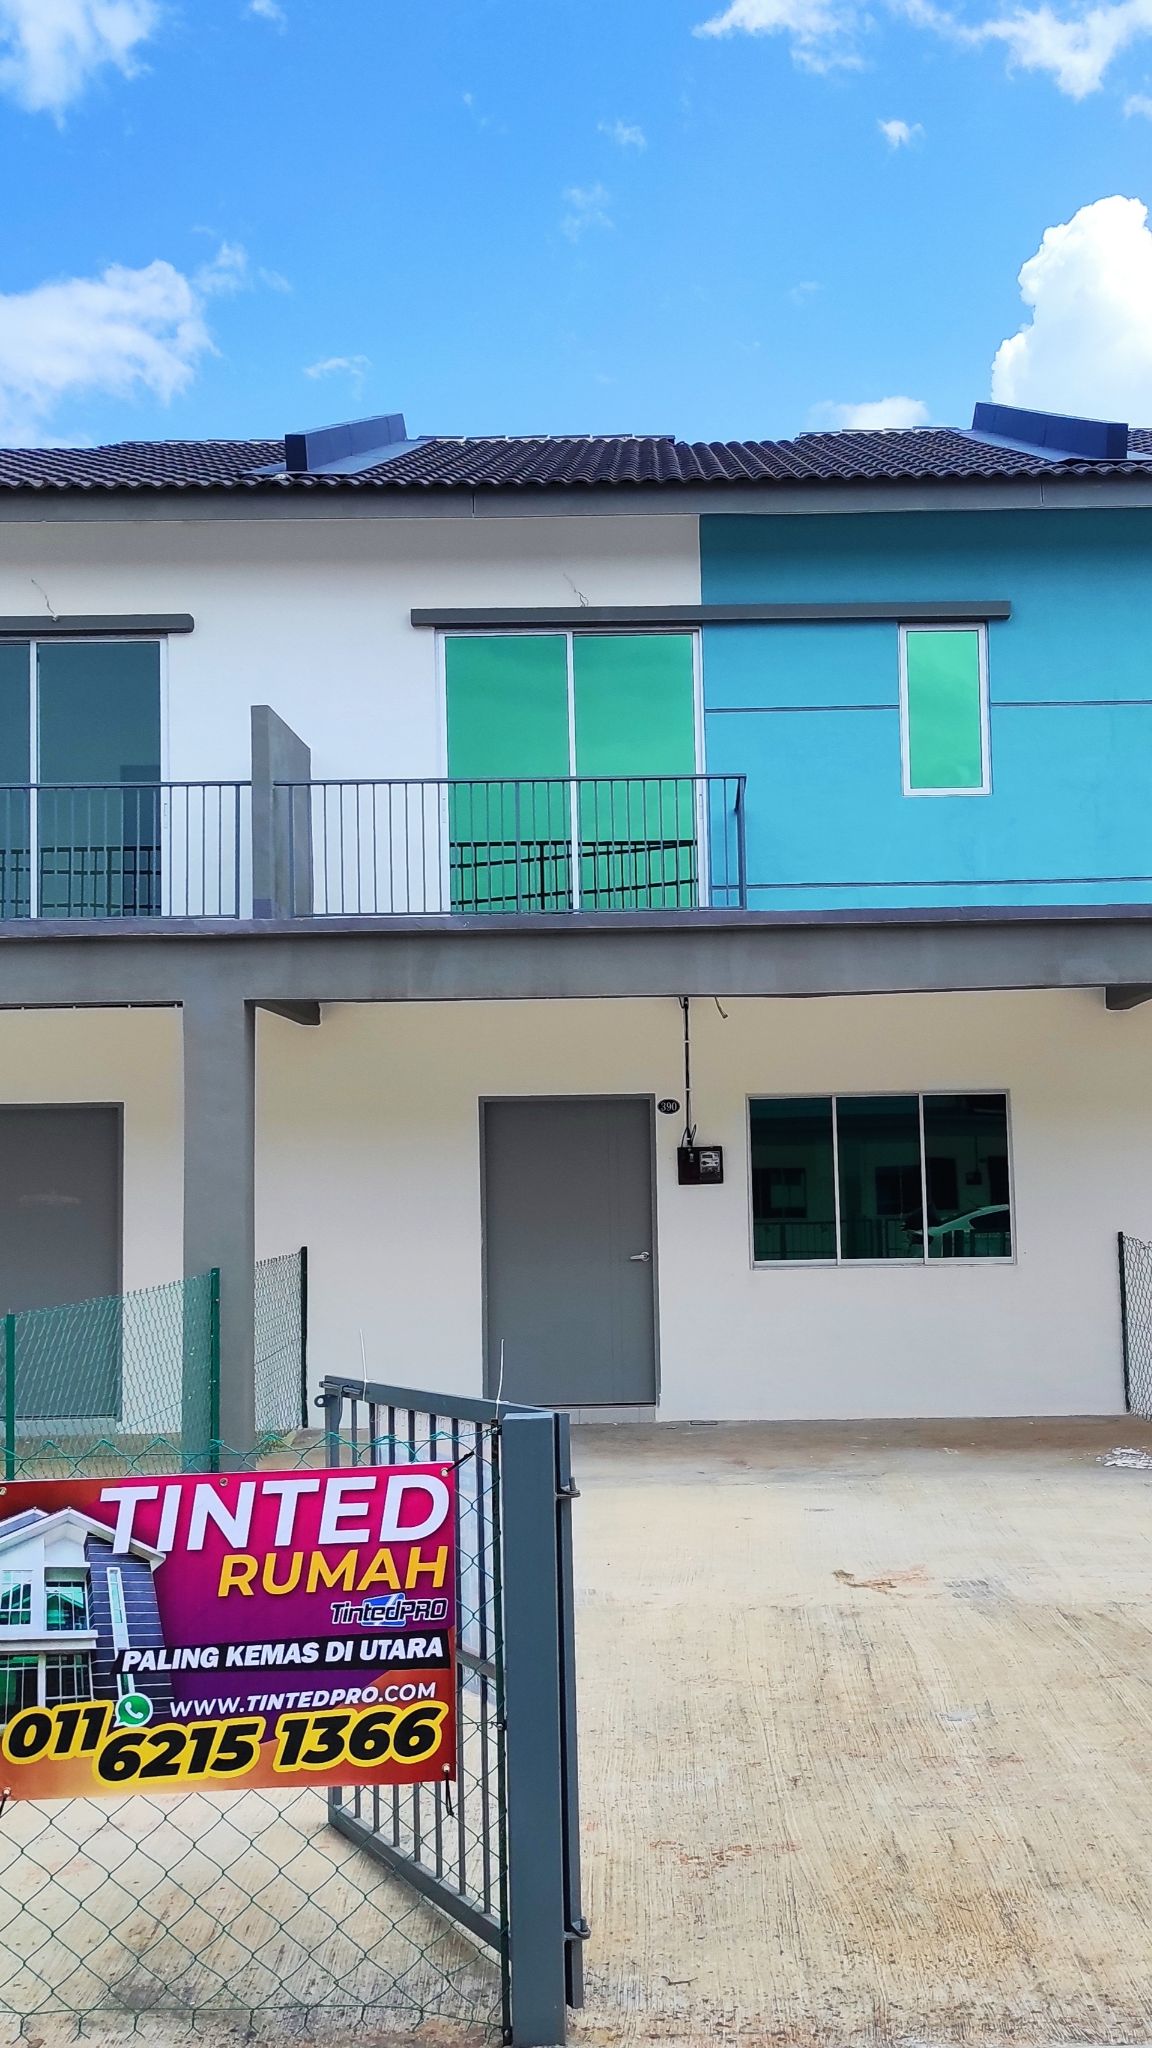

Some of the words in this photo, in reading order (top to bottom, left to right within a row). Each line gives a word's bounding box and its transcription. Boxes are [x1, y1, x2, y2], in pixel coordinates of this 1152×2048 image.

[660, 1101, 678, 1112] 390
[100, 1474, 450, 1554] TINTED
[217, 1545, 449, 1597] RUMAH
[330, 1598, 449, 1625] TintedPRO
[121, 1647, 220, 1673] PALING
[225, 1641, 320, 1668] KEMAS
[324, 1641, 354, 1663] DI
[359, 1637, 443, 1661] UTARA
[169, 1682, 437, 1718] WWW.TINTEDPRO.COM
[7, 1706, 108, 1759] 011
[98, 1722, 260, 1782] 6215
[279, 1706, 443, 1766] 1366
